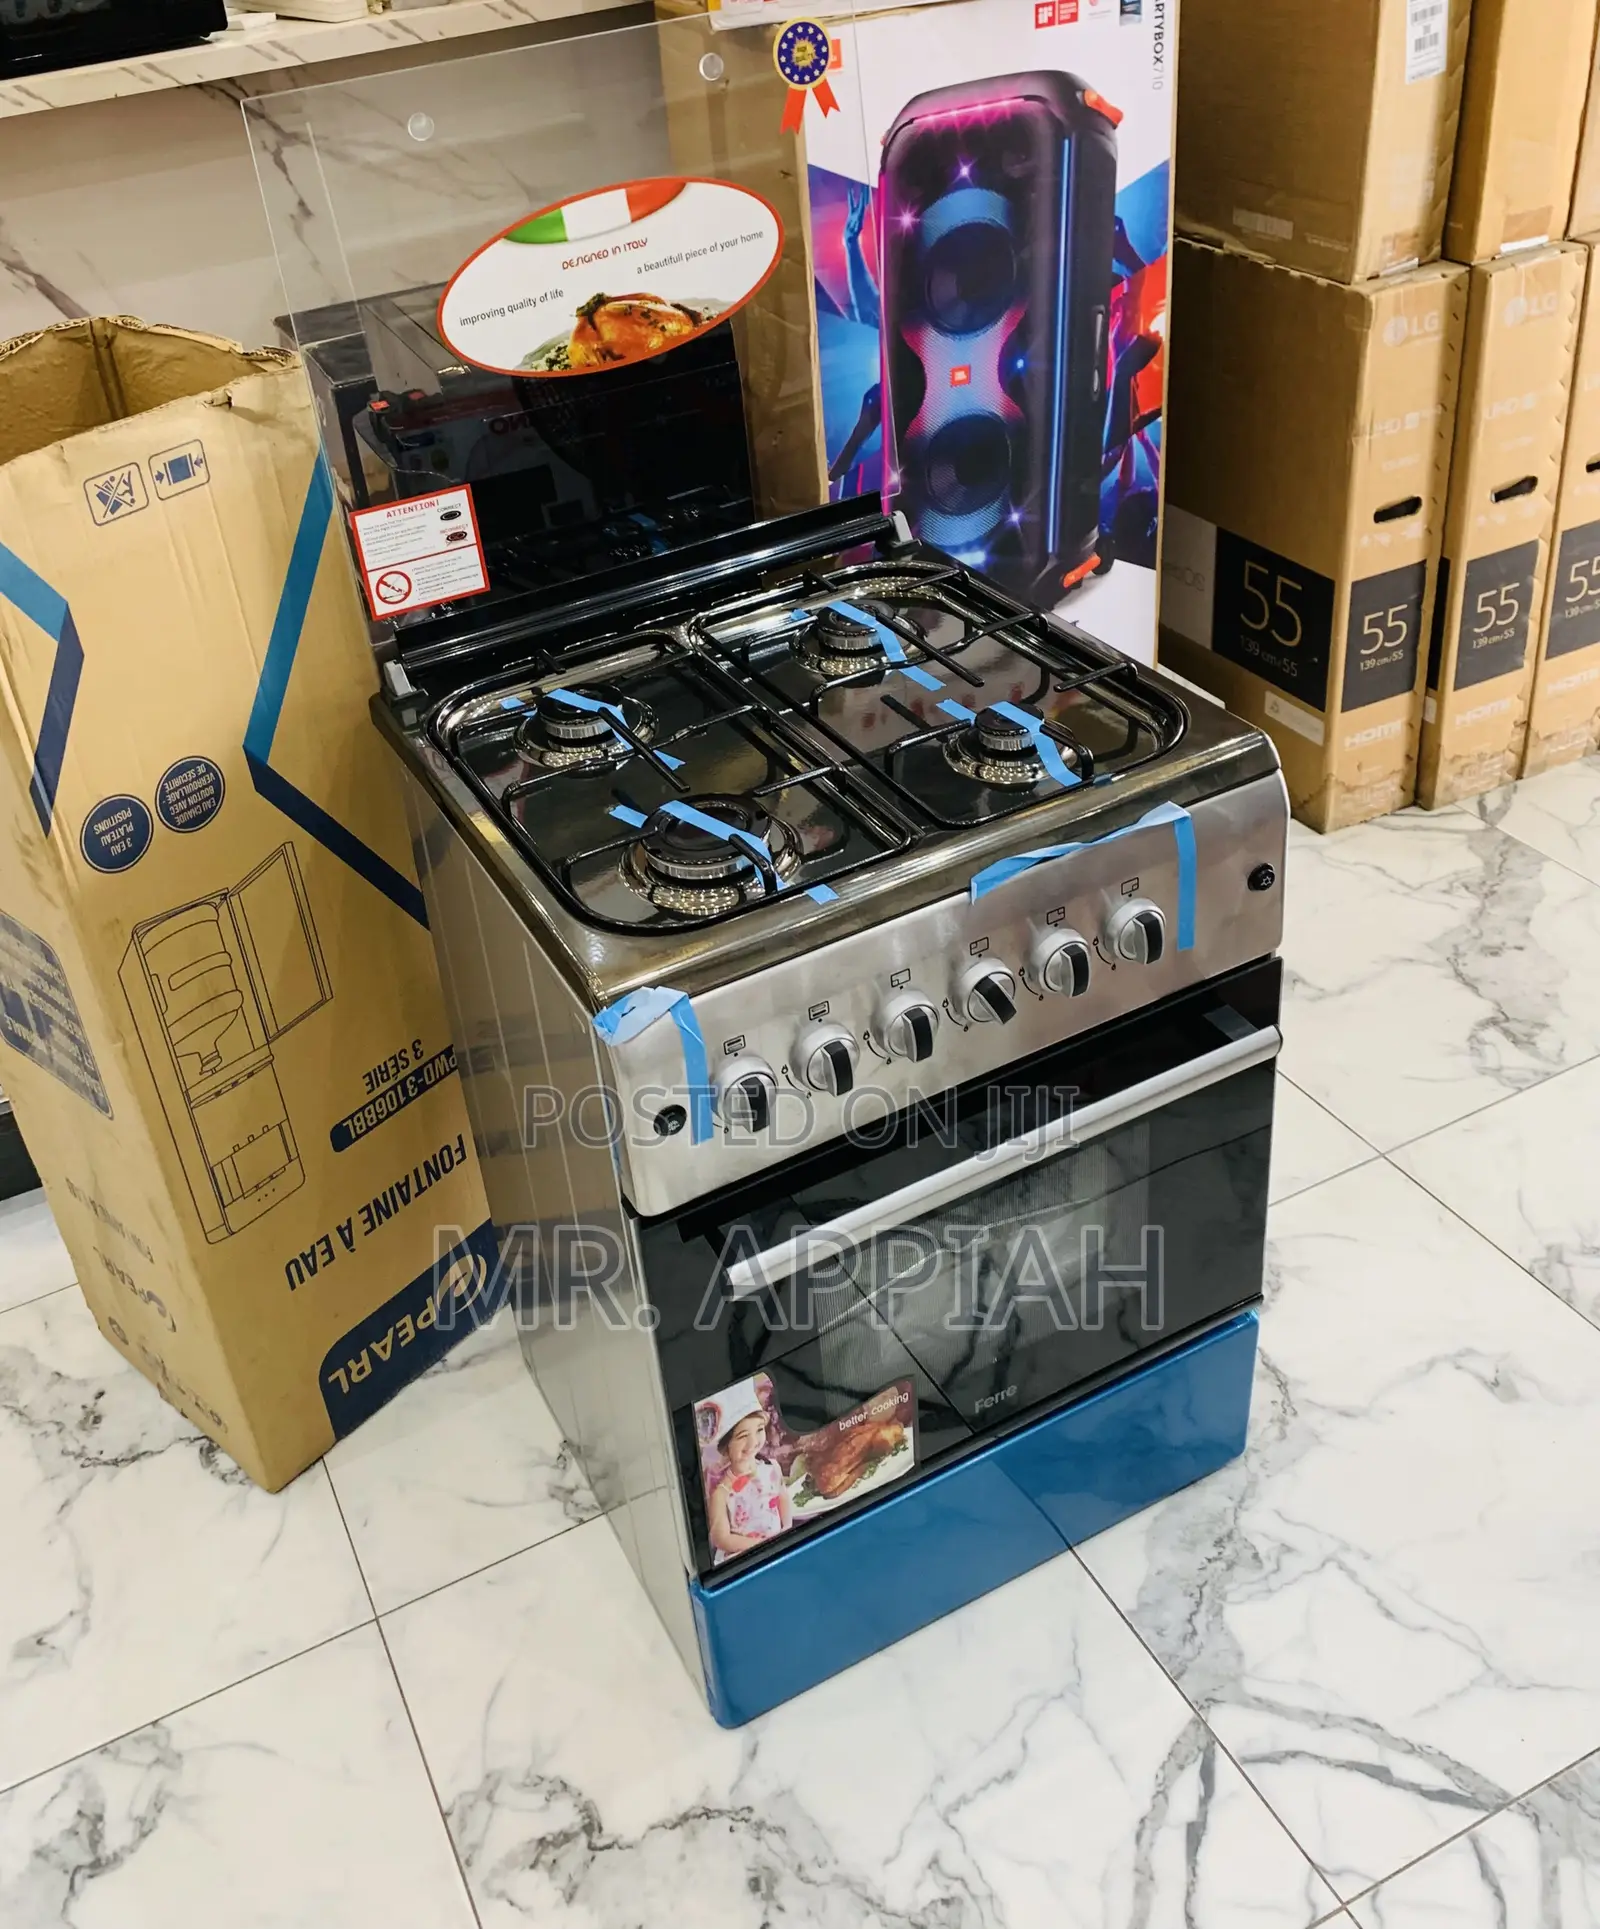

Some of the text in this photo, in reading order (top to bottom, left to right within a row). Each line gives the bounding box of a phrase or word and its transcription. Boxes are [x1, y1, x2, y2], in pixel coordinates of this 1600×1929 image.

[1152, 0, 1166, 90] RTYBOX710
[561, 248, 610, 271] DESIGNED
[636, 230, 764, 275] a beautifull piece of your home
[459, 288, 564, 327] improving quality of life
[1529, 292, 1558, 317] LG
[1411, 311, 1440, 337] LG
[1240, 560, 1302, 647] 55
[1473, 582, 1520, 633] 55
[1360, 604, 1408, 655] 55
[1472, 637, 1488, 650] 139
[1240, 635, 1260, 656] 139
[1360, 659, 1376, 672] 139
[195, 763, 206, 774] DE
[166, 772, 216, 804] VERROUILLAGE
[169, 785, 215, 816] BOUTON AVEC
[93, 807, 133, 835] POSITIONS
[175, 796, 216, 826] EAU CHAUDE
[100, 821, 134, 847] PLATEAU
[110, 837, 133, 856] 3 EAU
[362, 1039, 424, 1095] 3 SÉRIE
[284, 1133, 467, 1292] FONTAINE À EAU
[328, 1296, 438, 1394] PEARL
[839, 1391, 909, 1431] better cooking
[974, 1384, 1018, 1414] Ferre
